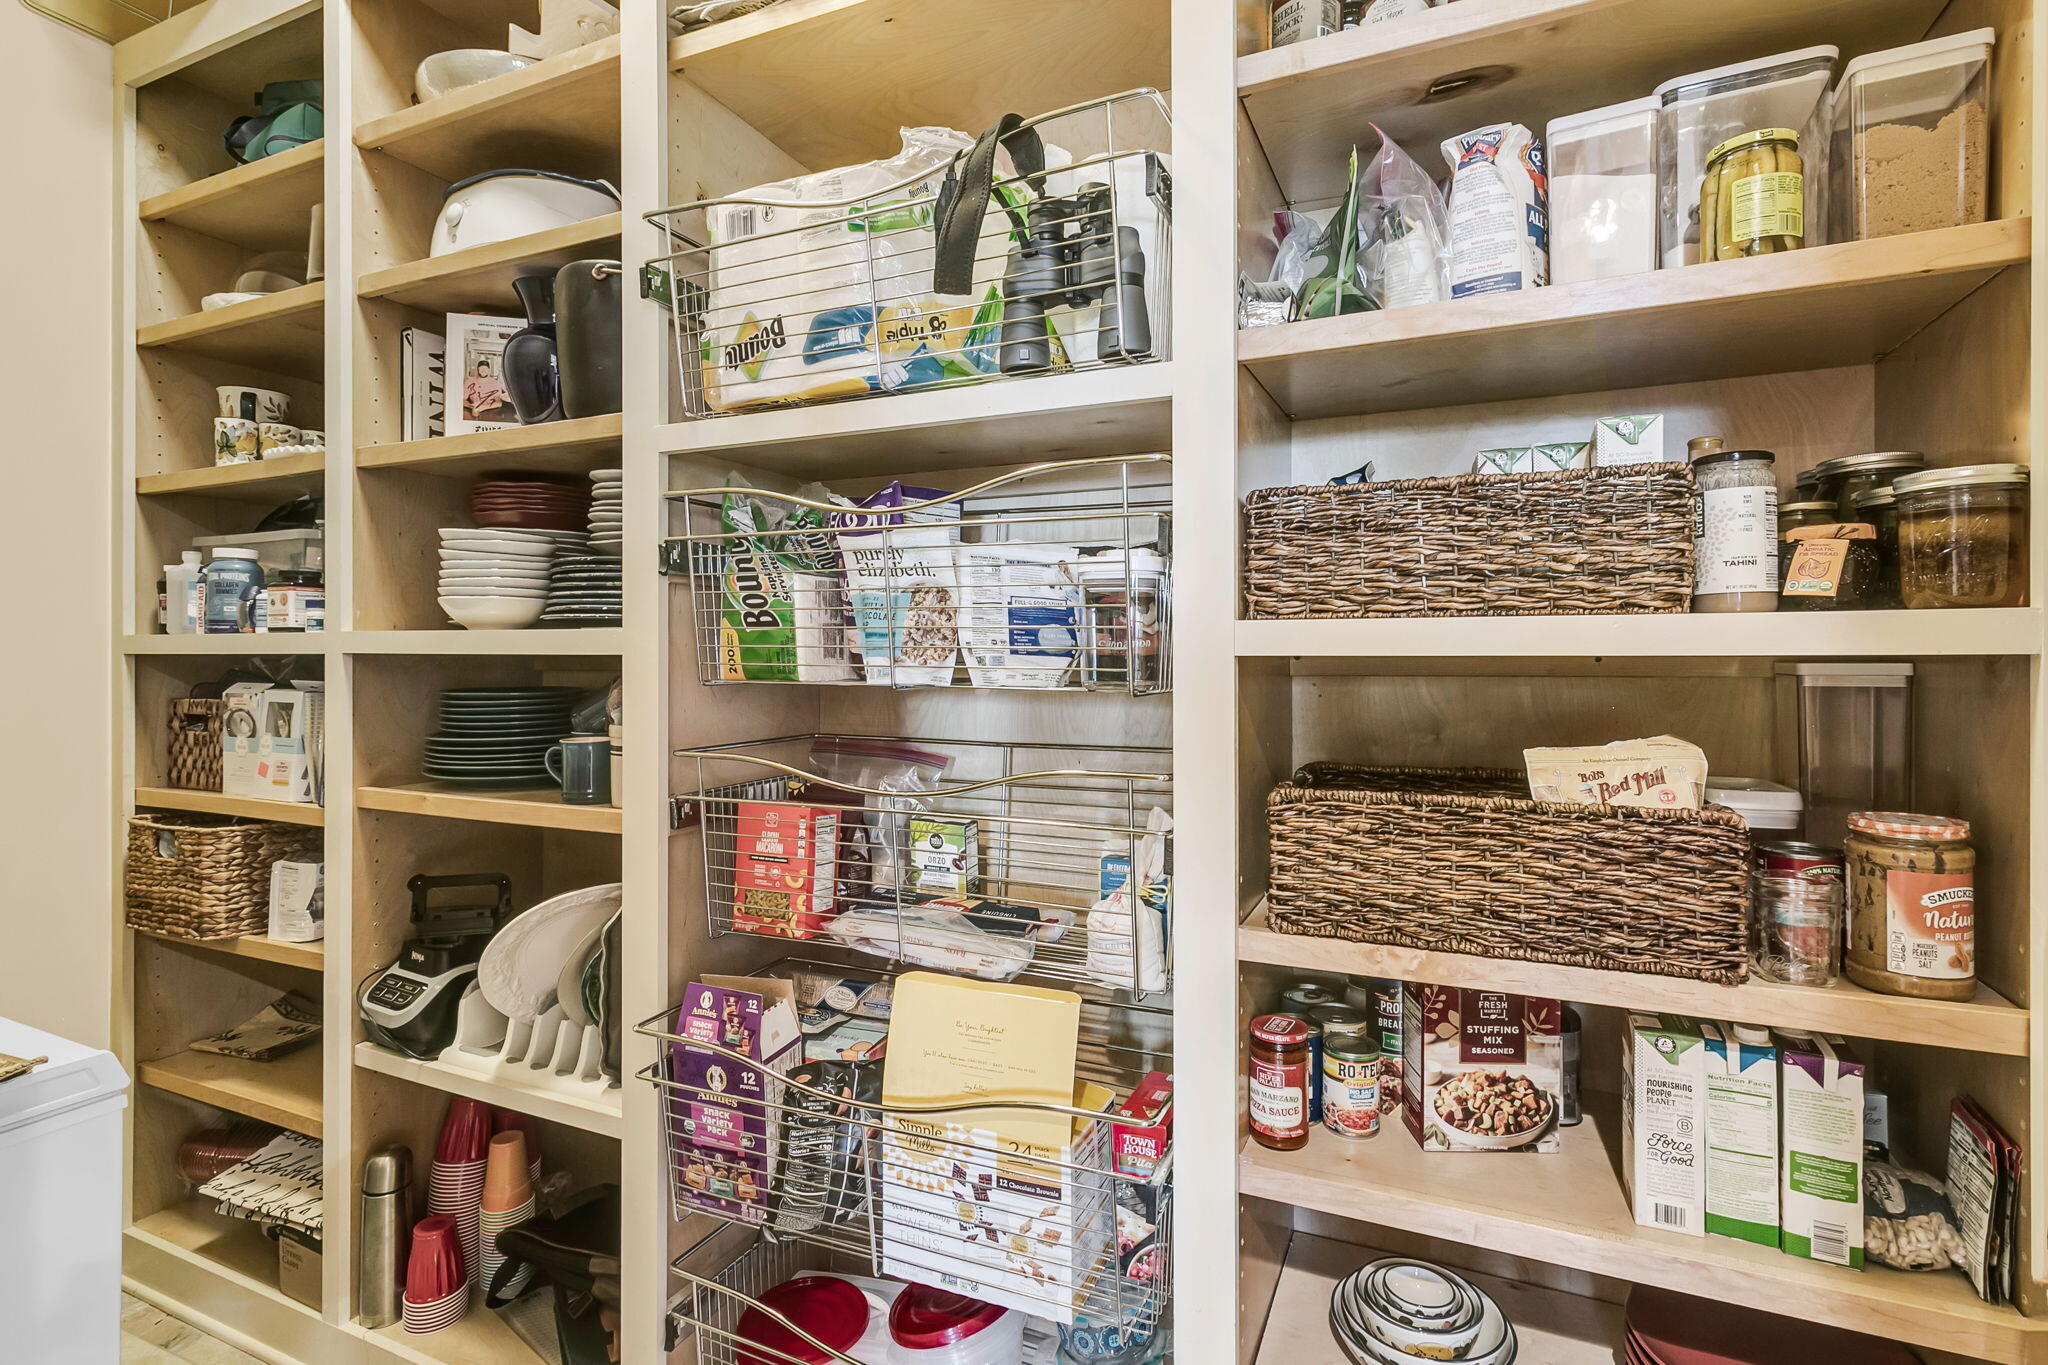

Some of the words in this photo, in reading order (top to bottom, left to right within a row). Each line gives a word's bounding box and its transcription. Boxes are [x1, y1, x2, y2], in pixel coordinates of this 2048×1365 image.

[1273, 15, 1303, 38] SHOCK!
[1528, 210, 1544, 228] ALL
[886, 323, 926, 343] Triple
[725, 314, 787, 372] Bounty
[853, 545, 905, 565] purely
[1722, 559, 1757, 567] TAHINI
[731, 535, 782, 633] Bounty
[1577, 770, 1605, 783] Bob's
[1597, 775, 1632, 802] Red
[1631, 766, 1667, 796] Mill
[755, 841, 784, 854] MACARONI
[927, 856, 946, 865] ORZO
[982, 909, 1017, 919] LINGUINE
[1935, 932, 1962, 941] PEANUT
[411, 951, 425, 963] NINJA
[1912, 949, 1938, 958] PEANUTS
[1918, 960, 1932, 968] SALT
[748, 999, 758, 1009] 12
[1478, 1001, 1508, 1009] FRESH
[691, 1007, 718, 1019] Annie's
[1466, 1026, 1520, 1034] STUFFING
[1483, 1036, 1503, 1045] MIX
[1471, 1047, 1515, 1055] SEASONED
[740, 1072, 756, 1085] 12
[1259, 1072, 1282, 1082] SILVER
[1259, 1078, 1283, 1088] PALATE
[1707, 1074, 1745, 1085] Nutrition
[1747, 1079, 1772, 1089] Facts
[739, 1084, 760, 1092] POUCHES
[1345, 1079, 1377, 1088] Original
[1260, 1091, 1299, 1104] MARZANO
[1360, 1088, 1374, 1096] SALT
[1708, 1093, 1736, 1101] Calories
[1647, 1096, 1676, 1107] PLANET
[703, 1108, 731, 1120] snack
[1269, 1106, 1300, 1117] SAUCE
[701, 1115, 733, 1129] variety
[898, 1118, 943, 1137] Simple
[906, 1134, 936, 1152] Mills
[1123, 1134, 1156, 1150] TOWN
[1647, 1132, 1693, 1153] Force
[1123, 1144, 1157, 1159] HOUSE
[1127, 1156, 1154, 1169] Pita
[1660, 1150, 1695, 1167] Good
[999, 1178, 1008, 1187] 12
[1008, 1182, 1036, 1193] Chocolate
[1036, 1187, 1059, 1197] Brownie
[896, 1213, 945, 1232] SWEET
